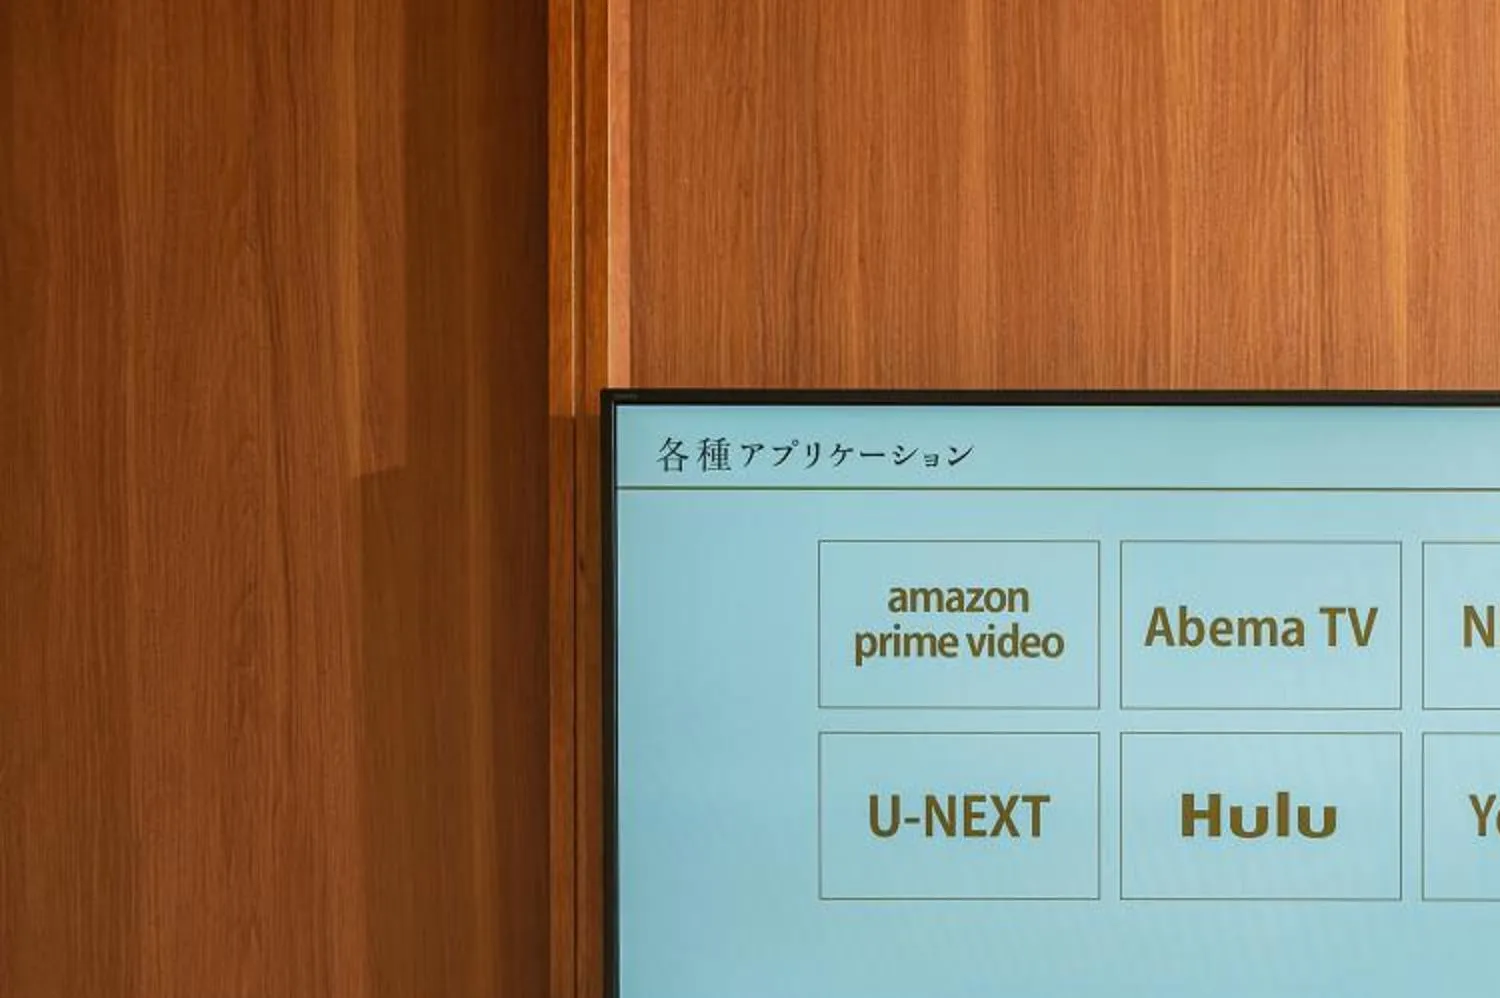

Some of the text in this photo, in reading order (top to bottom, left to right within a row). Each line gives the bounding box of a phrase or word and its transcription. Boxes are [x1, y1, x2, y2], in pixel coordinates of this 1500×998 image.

[656, 436, 974, 473] 各種アプリケーション
[887, 586, 1030, 613] amazon
[854, 622, 1065, 668] prime video
[1143, 604, 1379, 648] Abema TV
[869, 794, 1051, 839] U-NEXT
[1181, 791, 1337, 839] Hulu
